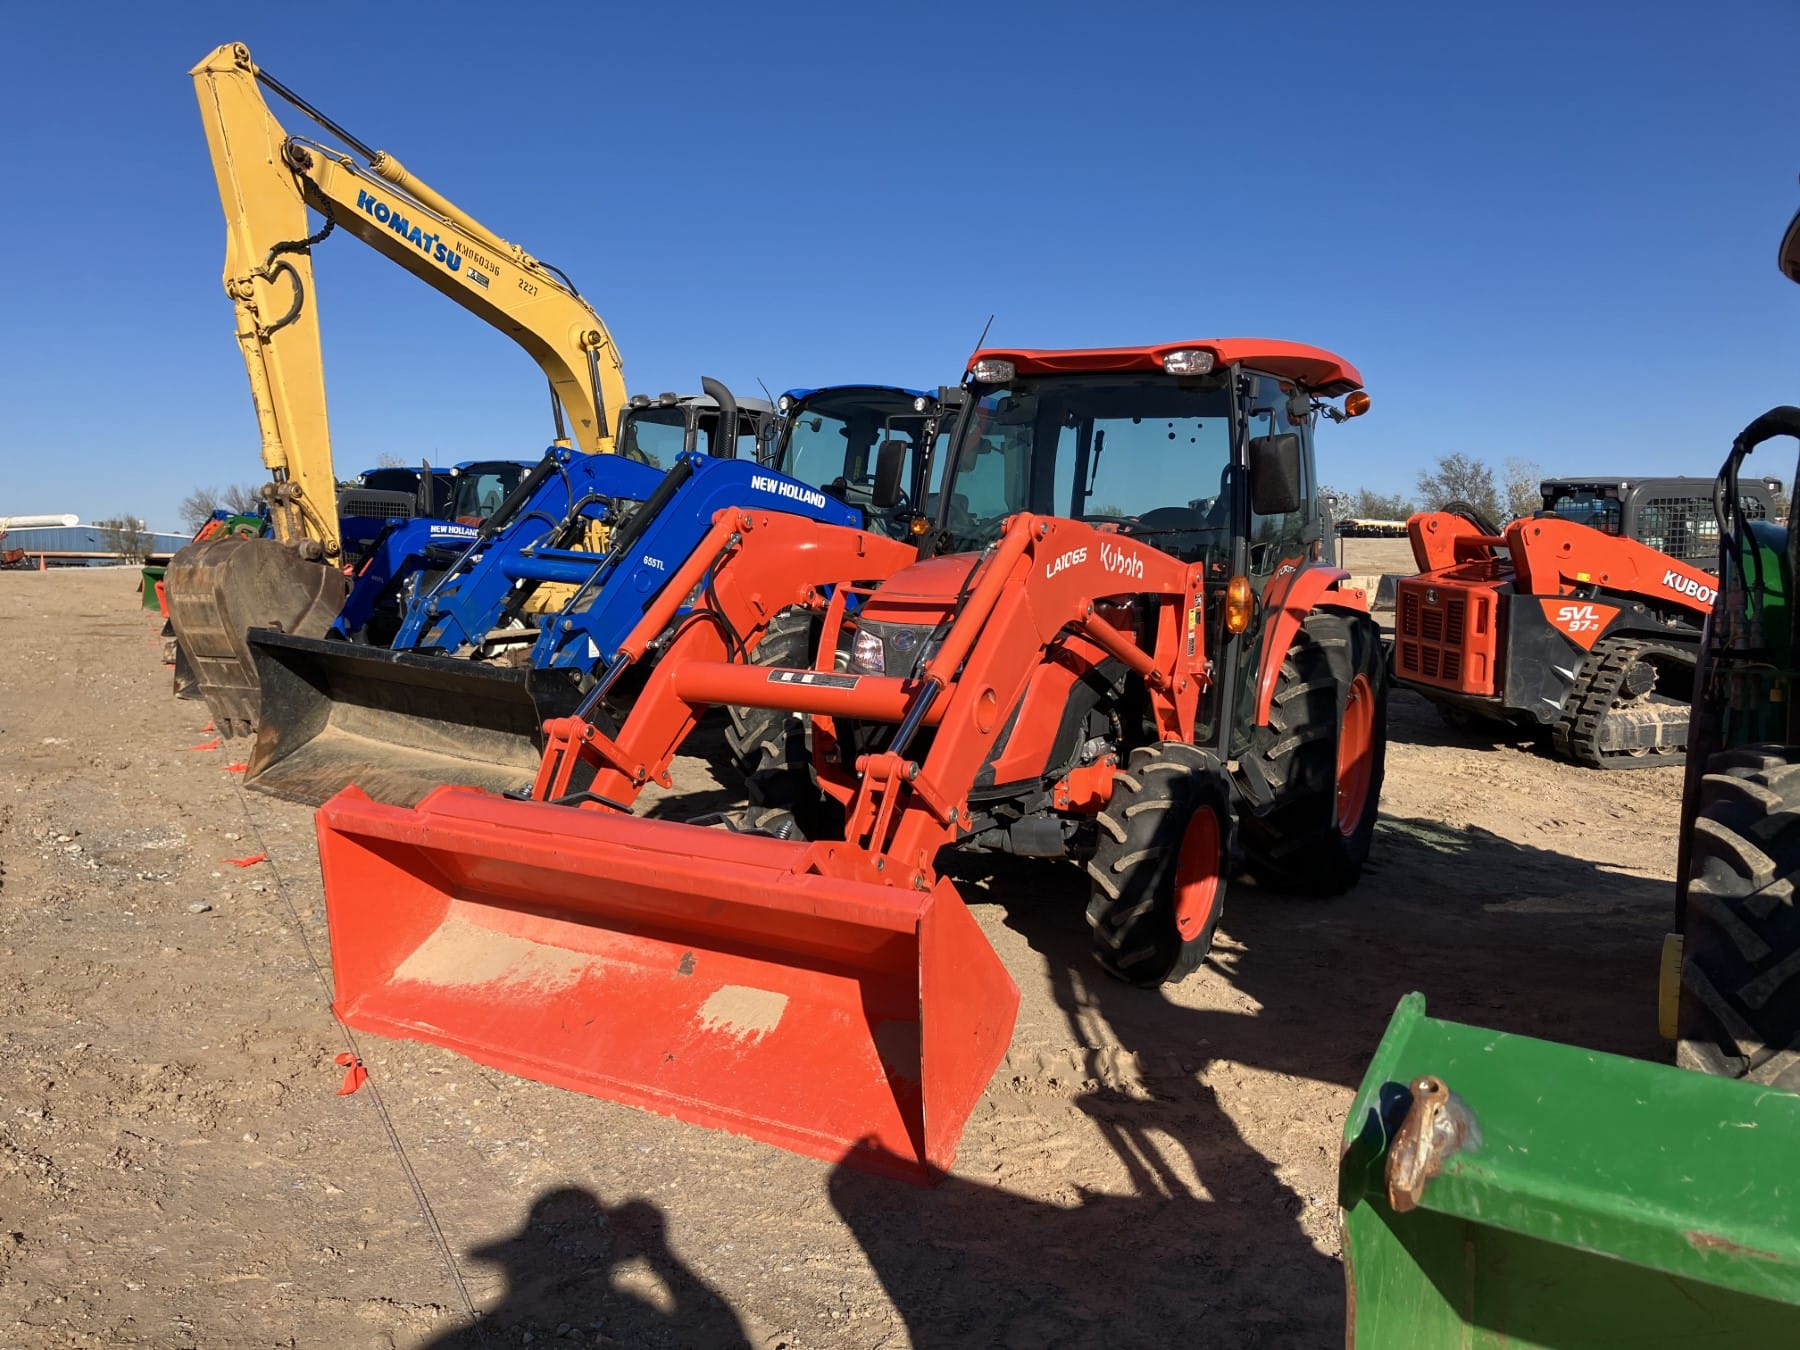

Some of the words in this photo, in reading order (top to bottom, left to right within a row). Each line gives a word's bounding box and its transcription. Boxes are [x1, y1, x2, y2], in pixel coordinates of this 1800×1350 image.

[357, 189, 462, 272] KOMATSU
[518, 278, 539, 297] 2227
[751, 475, 778, 494] NEW
[778, 481, 826, 509] HOLLAND
[430, 525, 448, 533] NEW
[643, 555, 665, 571] 655TL
[1046, 547, 1088, 579] LA1065
[1100, 542, 1144, 579] Kubota
[1556, 605, 1600, 621] SVL
